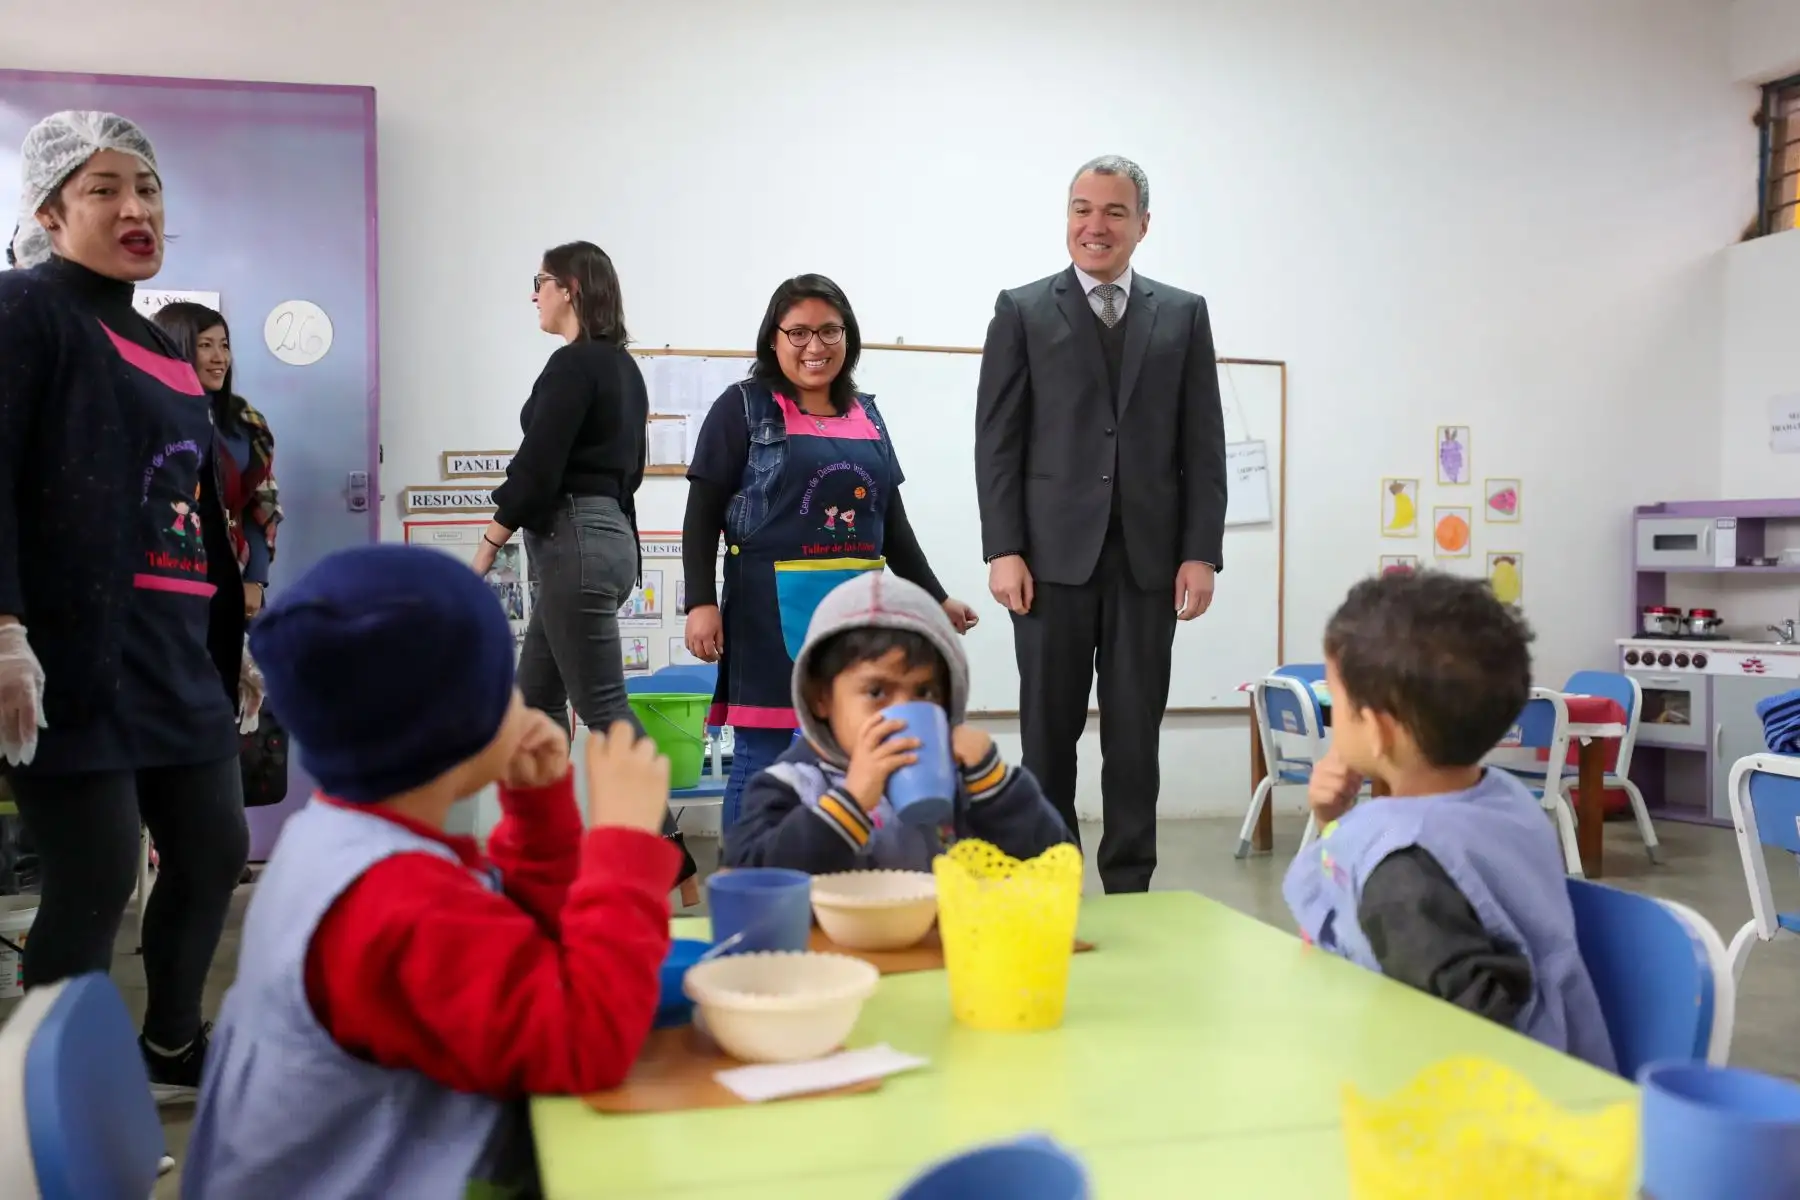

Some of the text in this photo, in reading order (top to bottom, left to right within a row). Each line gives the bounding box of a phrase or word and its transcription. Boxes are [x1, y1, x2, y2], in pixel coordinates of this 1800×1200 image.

[143, 294, 190, 305] 4 AÑO
[275, 311, 323, 355] 26
[453, 458, 504, 472] PANEL
[799, 461, 876, 515] Centro de Desarrollo Integral
[801, 542, 830, 556] Taller
